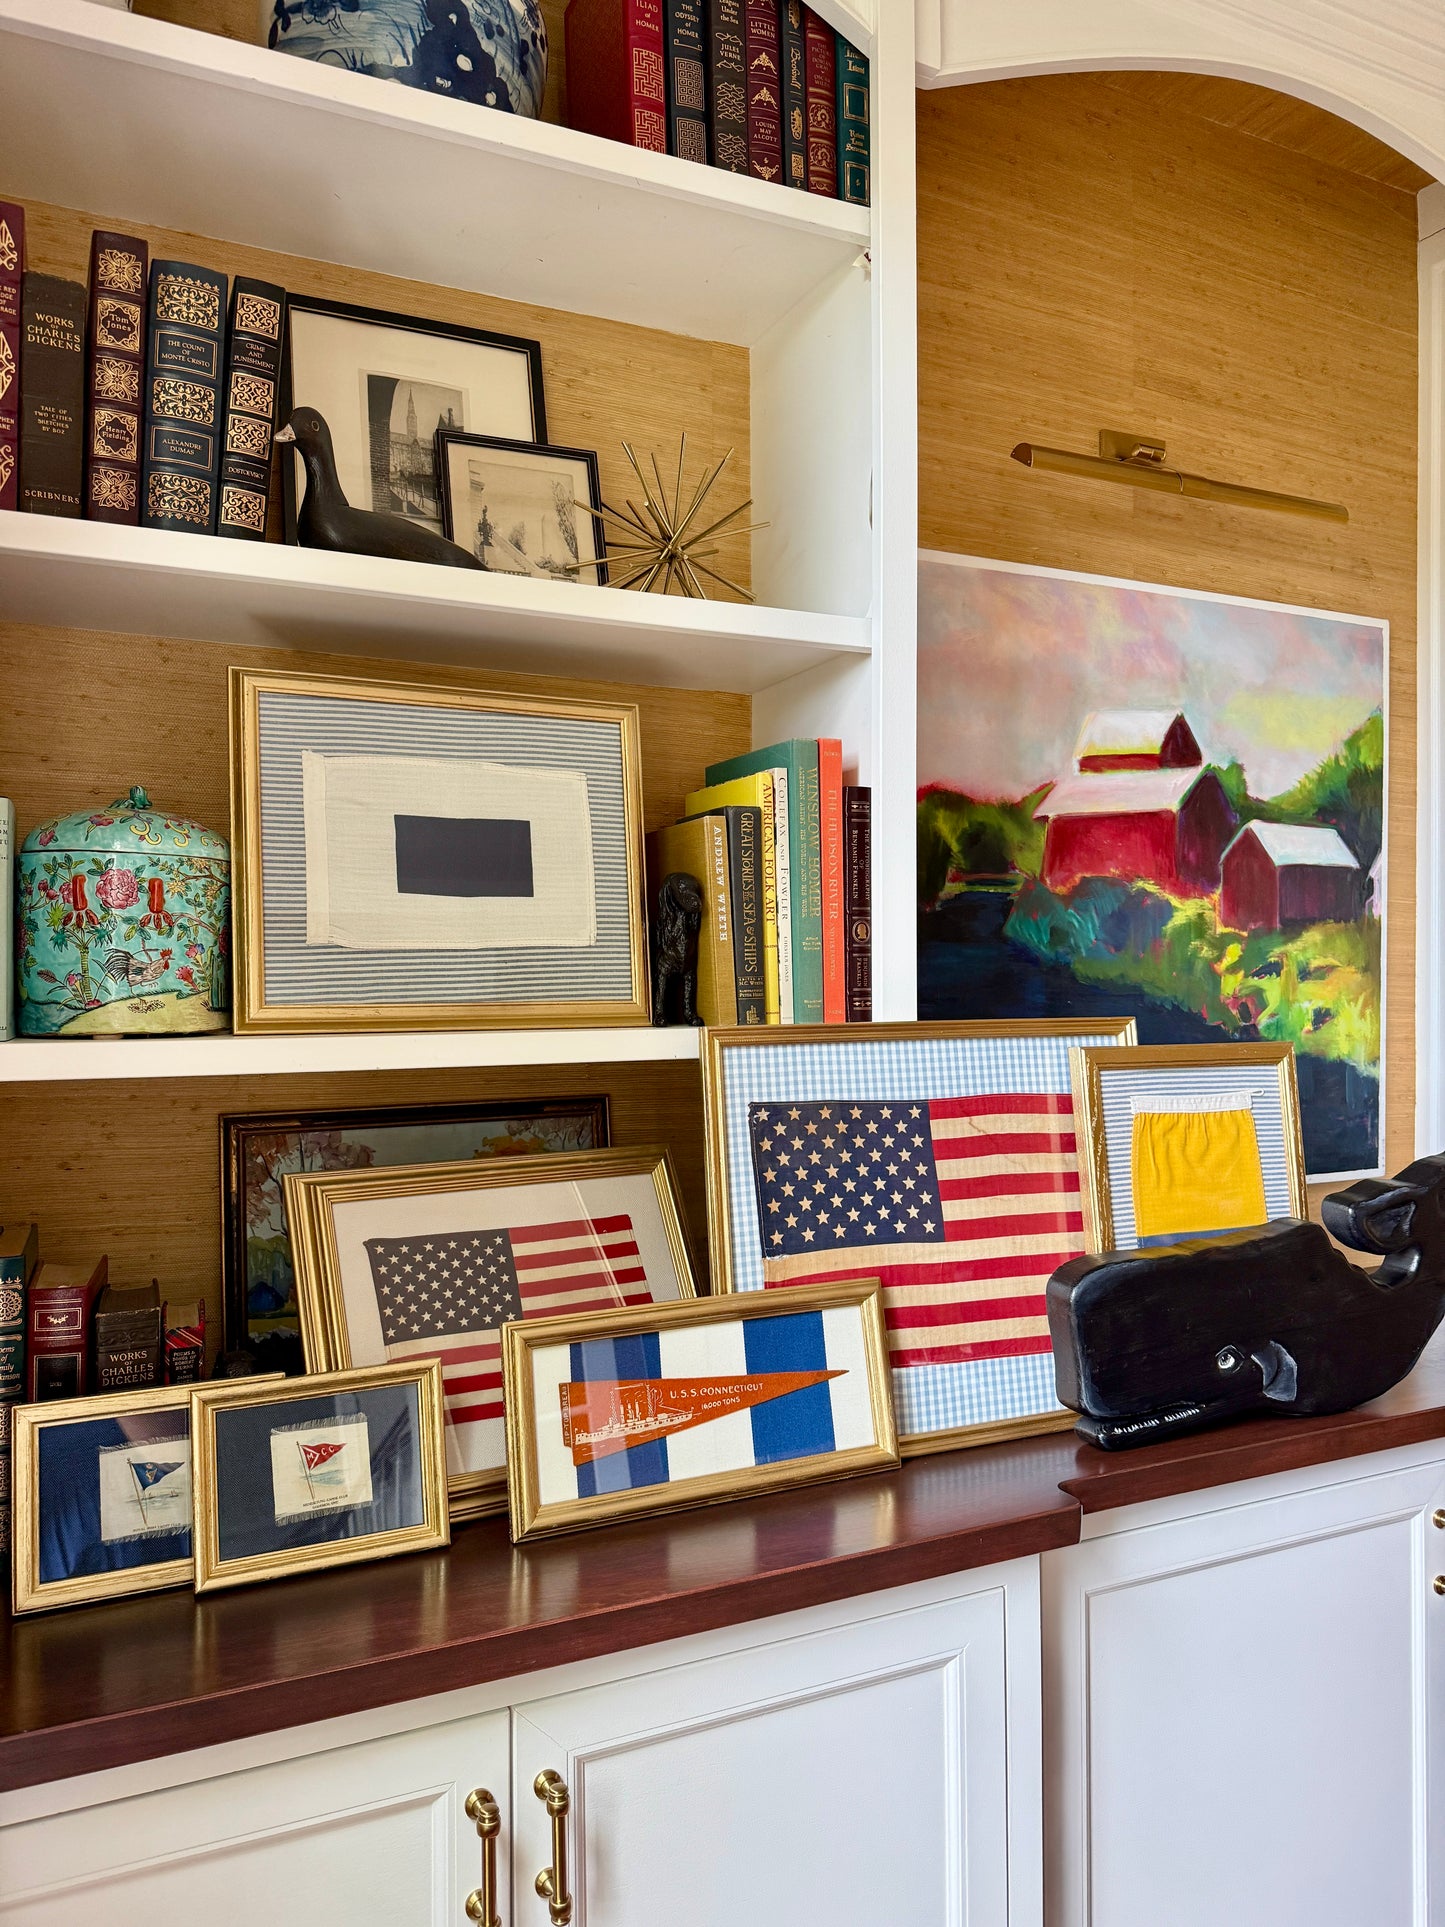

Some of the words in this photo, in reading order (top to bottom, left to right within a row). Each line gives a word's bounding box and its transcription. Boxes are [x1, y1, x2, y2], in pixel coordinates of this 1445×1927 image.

[681, 4, 693, 12] THE
[721, 5, 738, 16] Under
[674, 11, 699, 23] ODYSSEY
[720, 14, 729, 22] the
[730, 16, 739, 25] Sea
[635, 19, 659, 32] HOMER
[750, 21, 775, 32] LITTLE
[677, 28, 699, 38] HOMER
[750, 28, 775, 39] WOMEN
[721, 43, 740, 53] JULES
[719, 50, 741, 60] VERNE
[755, 121, 776, 130] LOUISA
[753, 134, 777, 143] ALCOTT
[0, 292, 14, 300] DGE
[3, 285, 17, 294] RED
[0, 305, 17, 316] RAGE
[35, 312, 74, 329] WORKS
[109, 313, 129, 324] Tom
[106, 320, 131, 332] Jones
[27, 324, 81, 343] CHARLES
[27, 334, 81, 352] DICKENS
[167, 340, 181, 348] THE
[181, 342, 205, 353] COUNT
[245, 343, 266, 353] CRIME
[161, 352, 186, 362] MONTE
[187, 356, 210, 368] CRISTO
[248, 350, 263, 359] AND
[234, 355, 275, 370] PUNISHMENT
[40, 405, 56, 413] TALE
[34, 410, 49, 418] TWO
[51, 413, 73, 422] CITIES
[37, 419, 70, 429] SKETCHES
[105, 425, 127, 435] Henry
[102, 431, 130, 443] Fielding
[162, 438, 203, 451] ALEXANDRE
[170, 446, 195, 455] DUMAS
[228, 466, 265, 480] DOSTOEVSKY
[24, 489, 80, 505] SCRIBNERS
[778, 777, 787, 837] COLEFAX
[828, 790, 837, 812] THE
[807, 767, 820, 851] WINSLOW
[763, 783, 774, 854] AMERICAN
[740, 812, 755, 848] GREAT
[828, 817, 838, 875] HUDSON
[713, 826, 726, 887] ANDREW
[741, 848, 755, 890] STORIES
[860, 860, 864, 869] OF
[764, 859, 775, 892] FOLK
[780, 867, 789, 920] FOWLER
[808, 857, 820, 917] HOMER
[829, 878, 838, 919] RIVER
[718, 892, 728, 942] WYETH
[743, 902, 757, 926] SEA
[765, 898, 776, 926] ART
[744, 935, 757, 973] SHIPS
[1, 1353, 9, 1364] of
[109, 1350, 148, 1363] WORKS
[0, 1363, 14, 1373] mily
[101, 1363, 154, 1377] CHARLES
[102, 1372, 155, 1387] DICKENS
[700, 1383, 763, 1396] CONNECTICUT
[701, 1401, 721, 1410] 16,000
[722, 1396, 740, 1405] TONS
[306, 1452, 314, 1461] M
[321, 1448, 327, 1456] C
[328, 1445, 335, 1453] C
